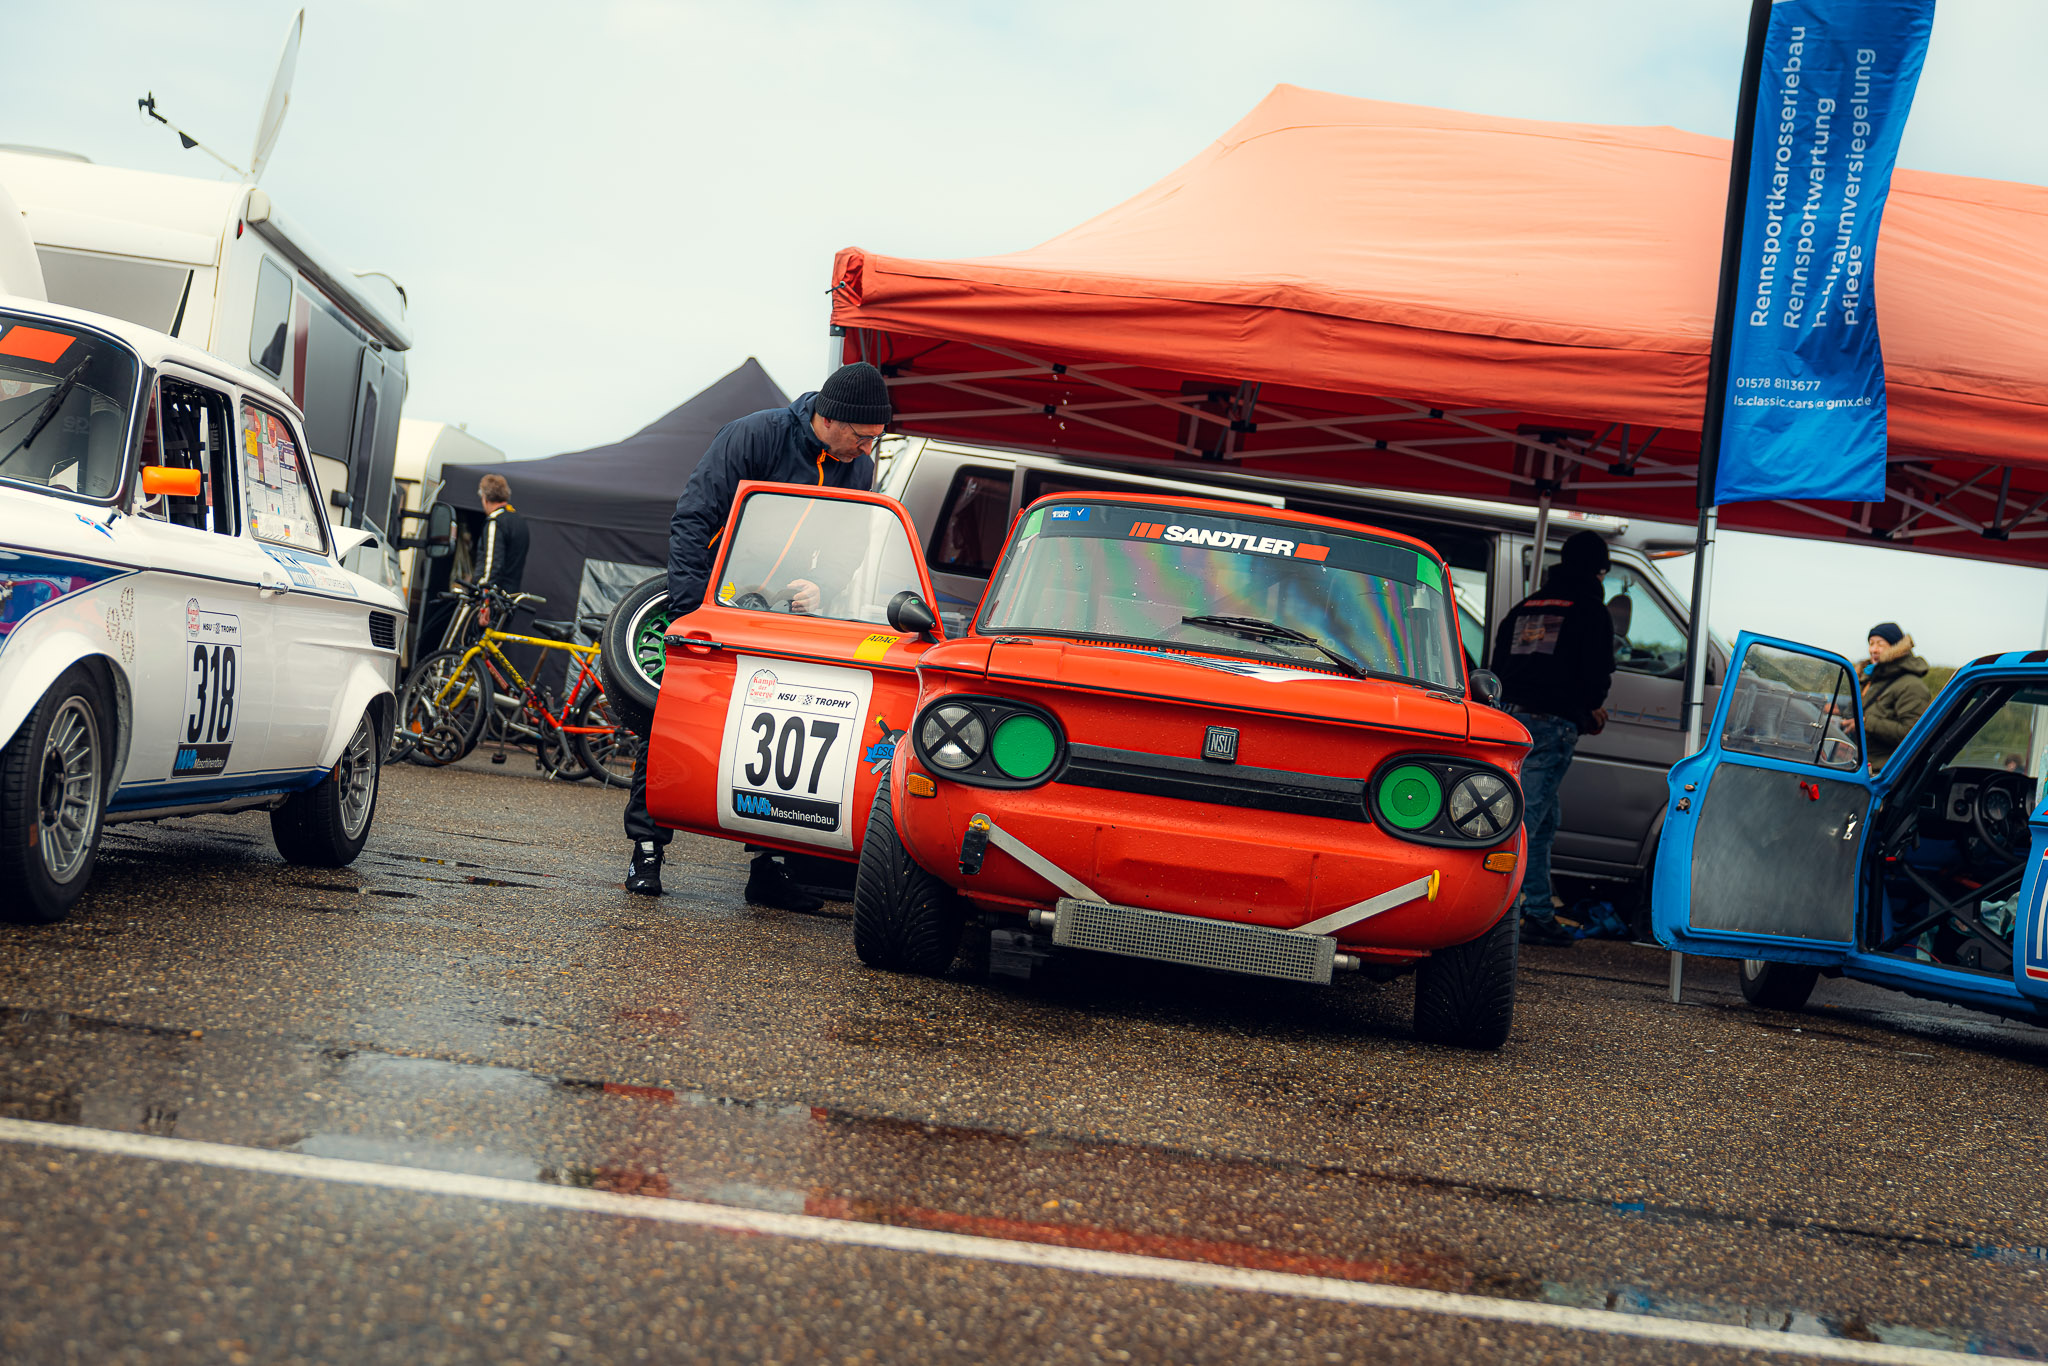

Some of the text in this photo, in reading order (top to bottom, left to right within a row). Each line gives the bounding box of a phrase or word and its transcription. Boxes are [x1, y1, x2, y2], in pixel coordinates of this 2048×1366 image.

[1750, 26, 1806, 327] Rennsportkarosseriebau
[1783, 98, 1836, 328] Rennsportwartung
[1736, 377, 1821, 391] 01578 8113677
[1734, 395, 1872, 410] ls.classic.cars@gmx.de
[1164, 525, 1295, 557] SANDTLER
[202, 623, 237, 633] NSU TROPHY
[867, 635, 898, 644] ADAC
[753, 676, 776, 687] Kampf
[187, 644, 236, 743] 318
[750, 688, 773, 699] Zwerge
[777, 692, 852, 709] NSU TROPHY
[1210, 733, 1232, 753] NSU
[744, 712, 840, 795] 307
